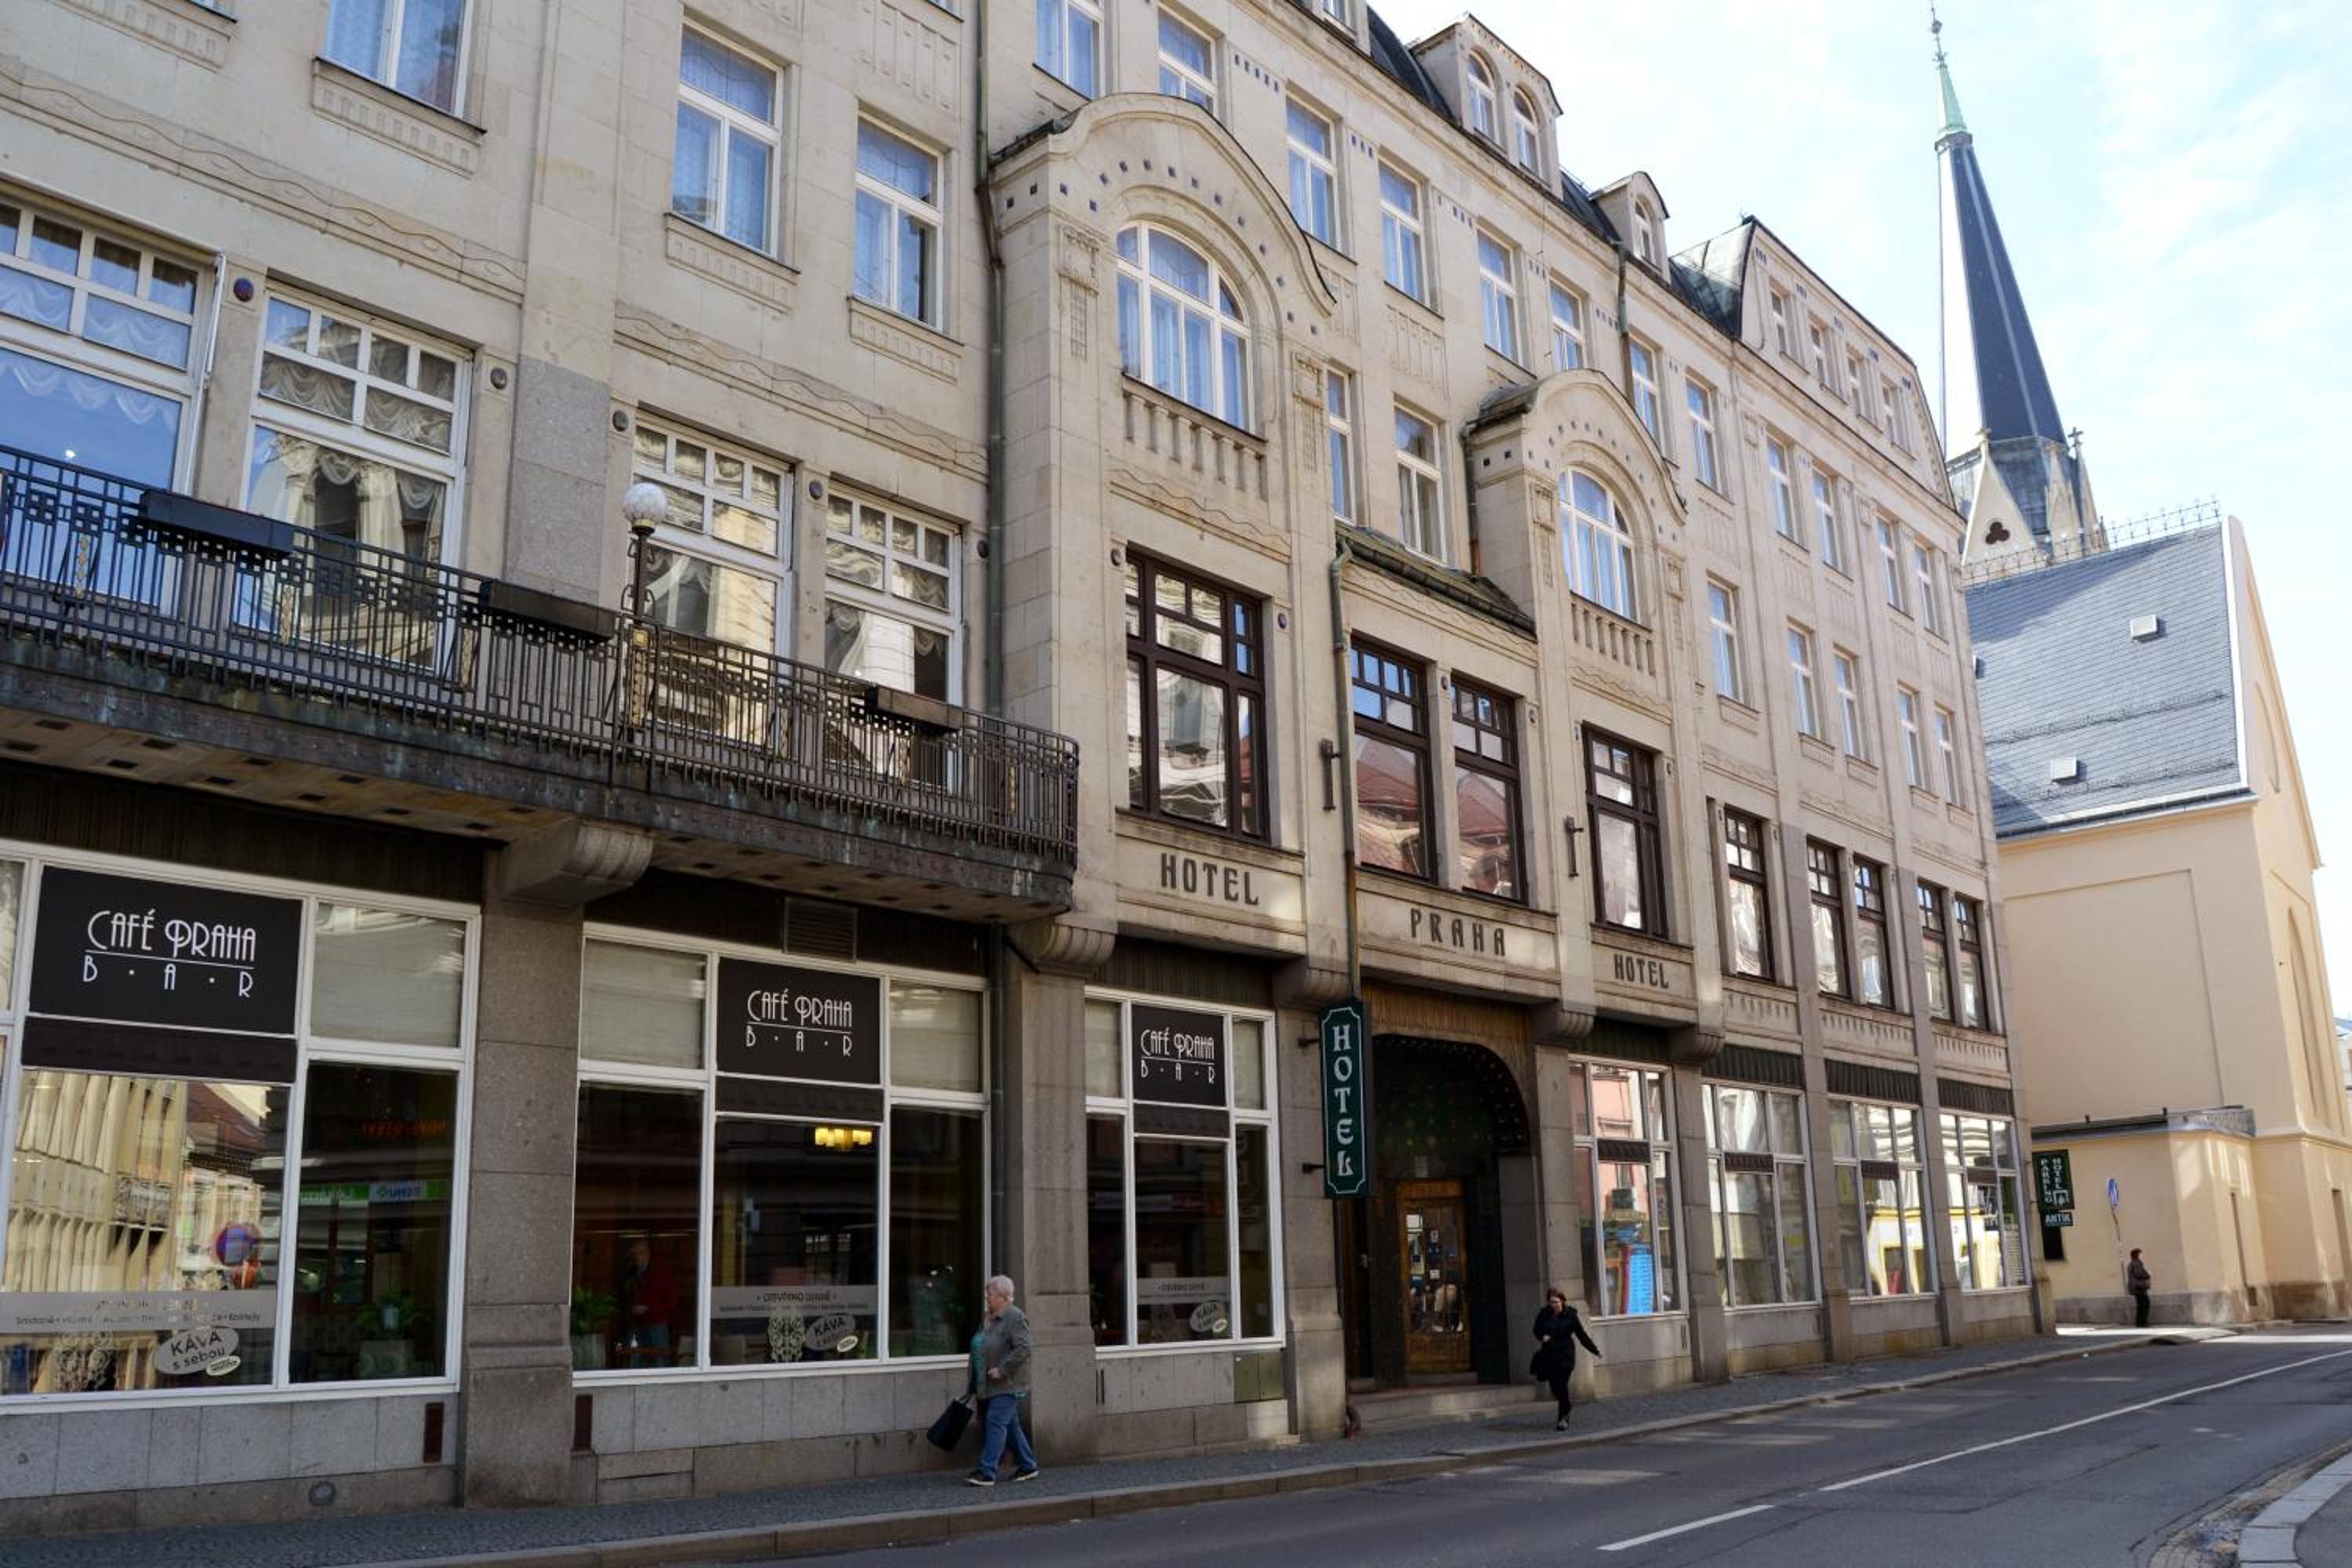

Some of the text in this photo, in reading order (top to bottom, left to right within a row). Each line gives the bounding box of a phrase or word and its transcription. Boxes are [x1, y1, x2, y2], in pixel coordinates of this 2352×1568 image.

[1160, 852, 1259, 906] HOTEL
[87, 909, 256, 961] CAFÉ PRAHA
[1410, 907, 1505, 956] PRAHA
[1613, 953, 1669, 989] HOTEL
[746, 988, 853, 1029] CAFÉ PRAHA
[1141, 1027, 1215, 1060] CAFÉ PRAHA
[1332, 1024, 1354, 1176] HOTEL
[2053, 1157, 2063, 1189] HOTEL
[183, 1347, 225, 1366] sebou
